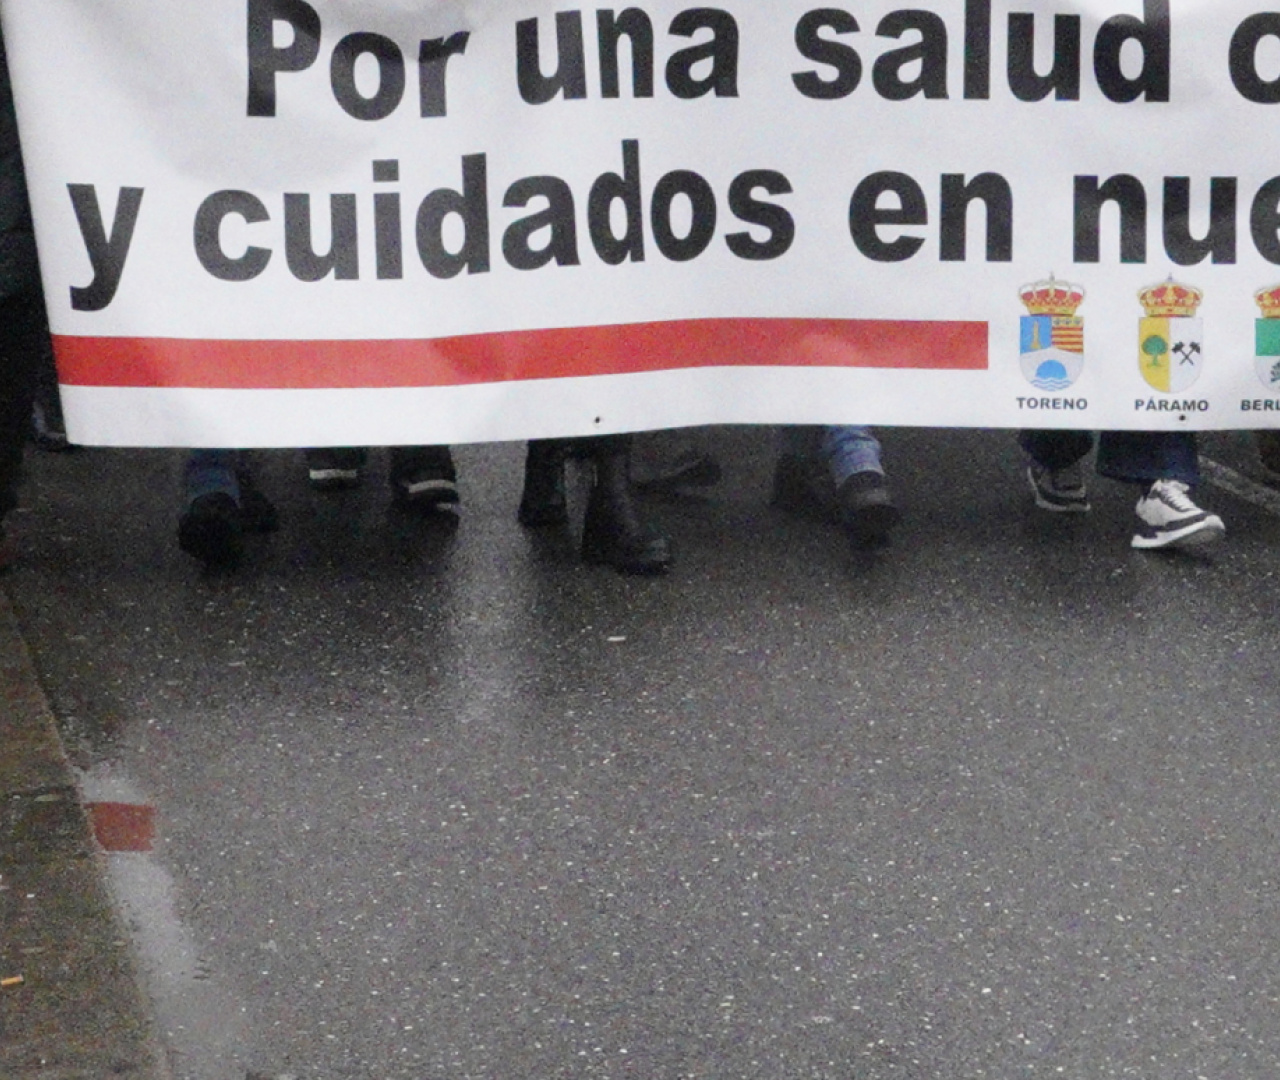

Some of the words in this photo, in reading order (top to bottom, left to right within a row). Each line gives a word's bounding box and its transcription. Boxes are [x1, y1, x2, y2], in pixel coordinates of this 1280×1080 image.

[504, 7, 739, 104] una
[68, 184, 143, 312] y
[195, 139, 795, 280] cuidados
[849, 171, 1013, 262] en
[1016, 397, 1088, 410] TORENO
[1135, 396, 1209, 412] PÁRAMO
